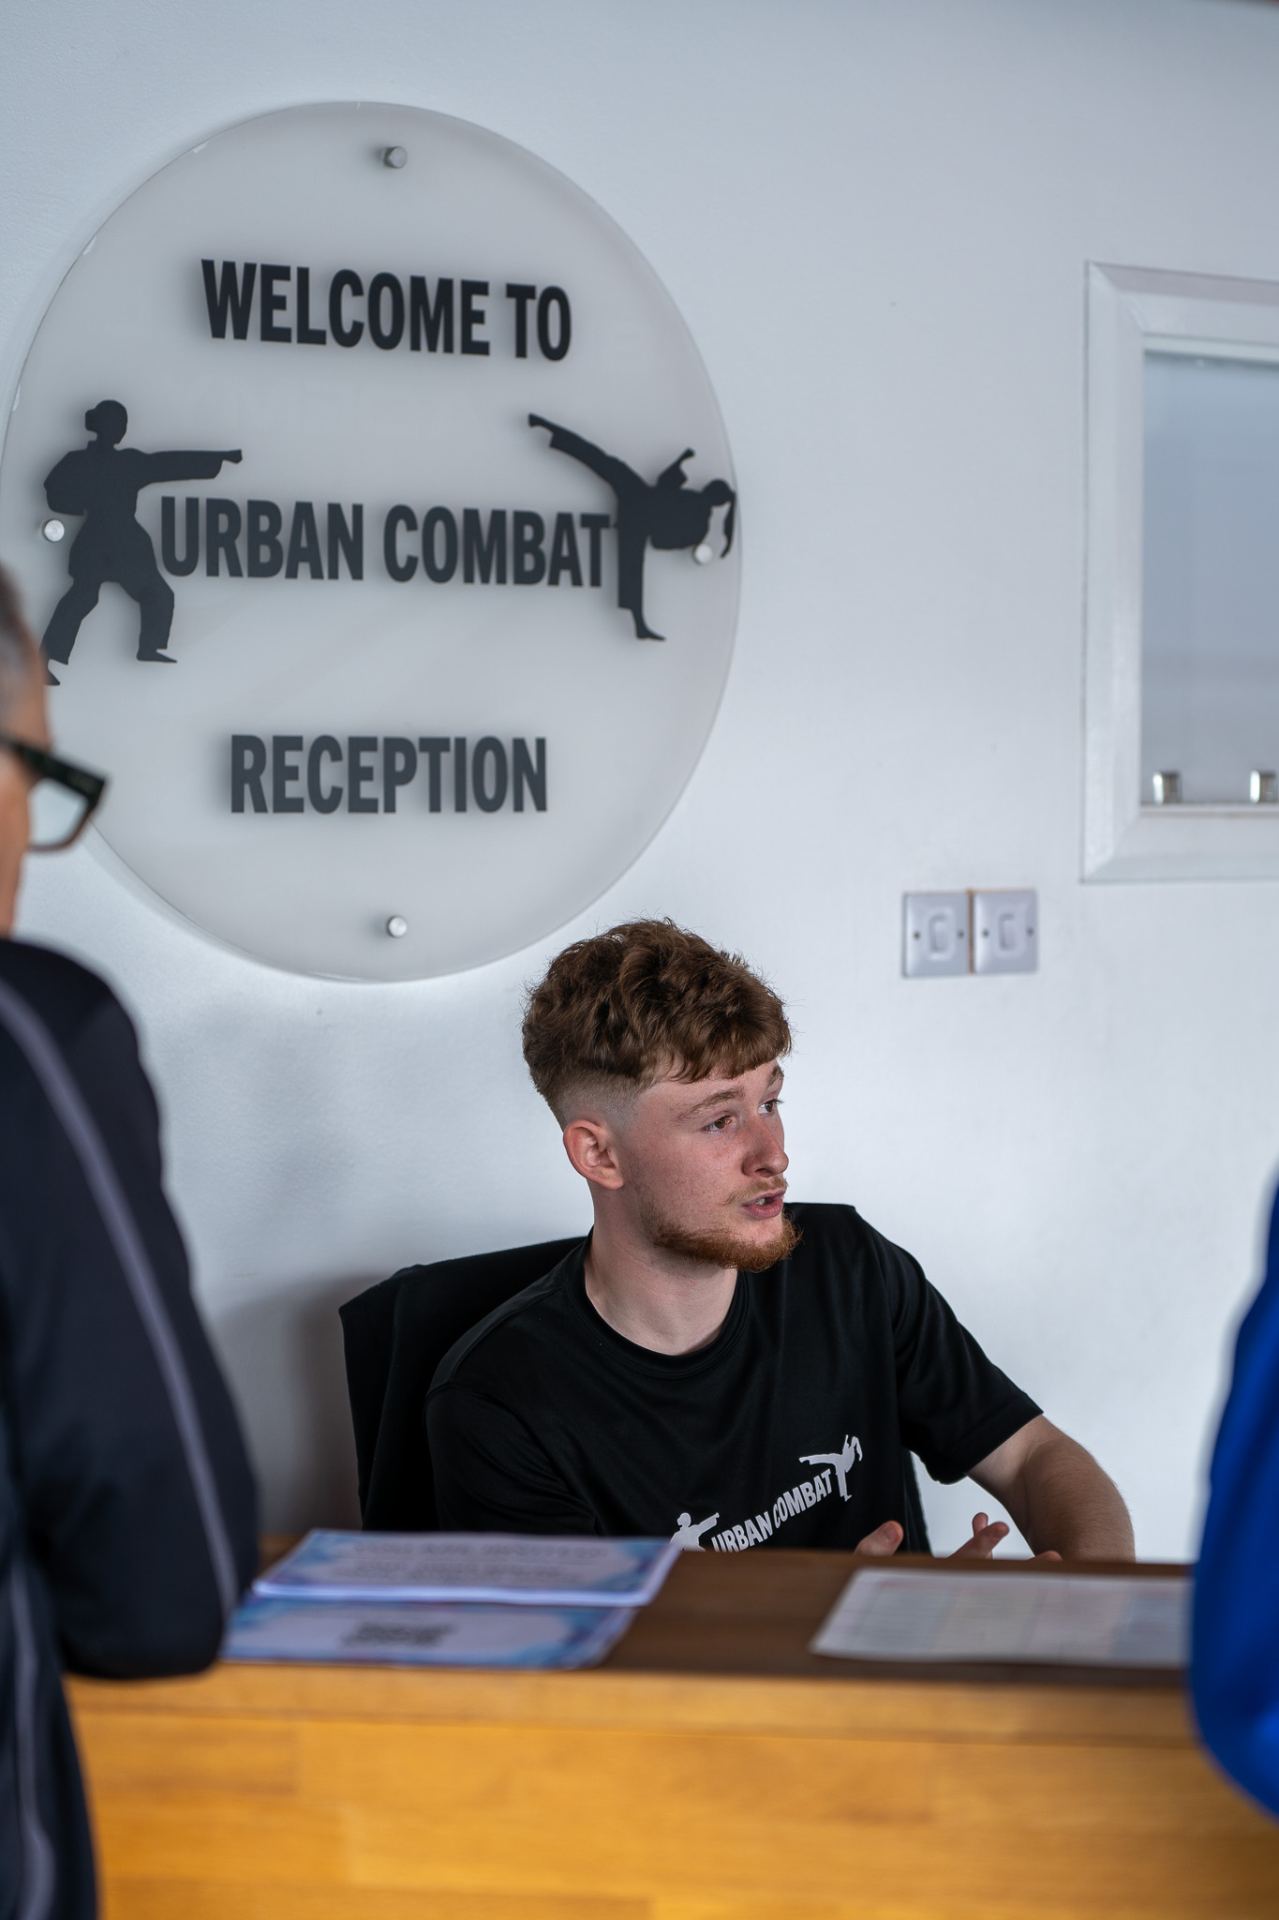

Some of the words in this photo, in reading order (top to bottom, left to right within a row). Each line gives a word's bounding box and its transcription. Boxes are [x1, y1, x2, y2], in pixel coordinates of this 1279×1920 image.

[201, 258, 491, 357] WELCOME
[505, 283, 572, 362] TO
[161, 495, 364, 581] URBAN
[383, 505, 610, 588] COMBAT
[230, 734, 547, 815] RECEPTION
[711, 1511, 774, 1552] URBAN
[772, 1468, 832, 1529] COMBAT
